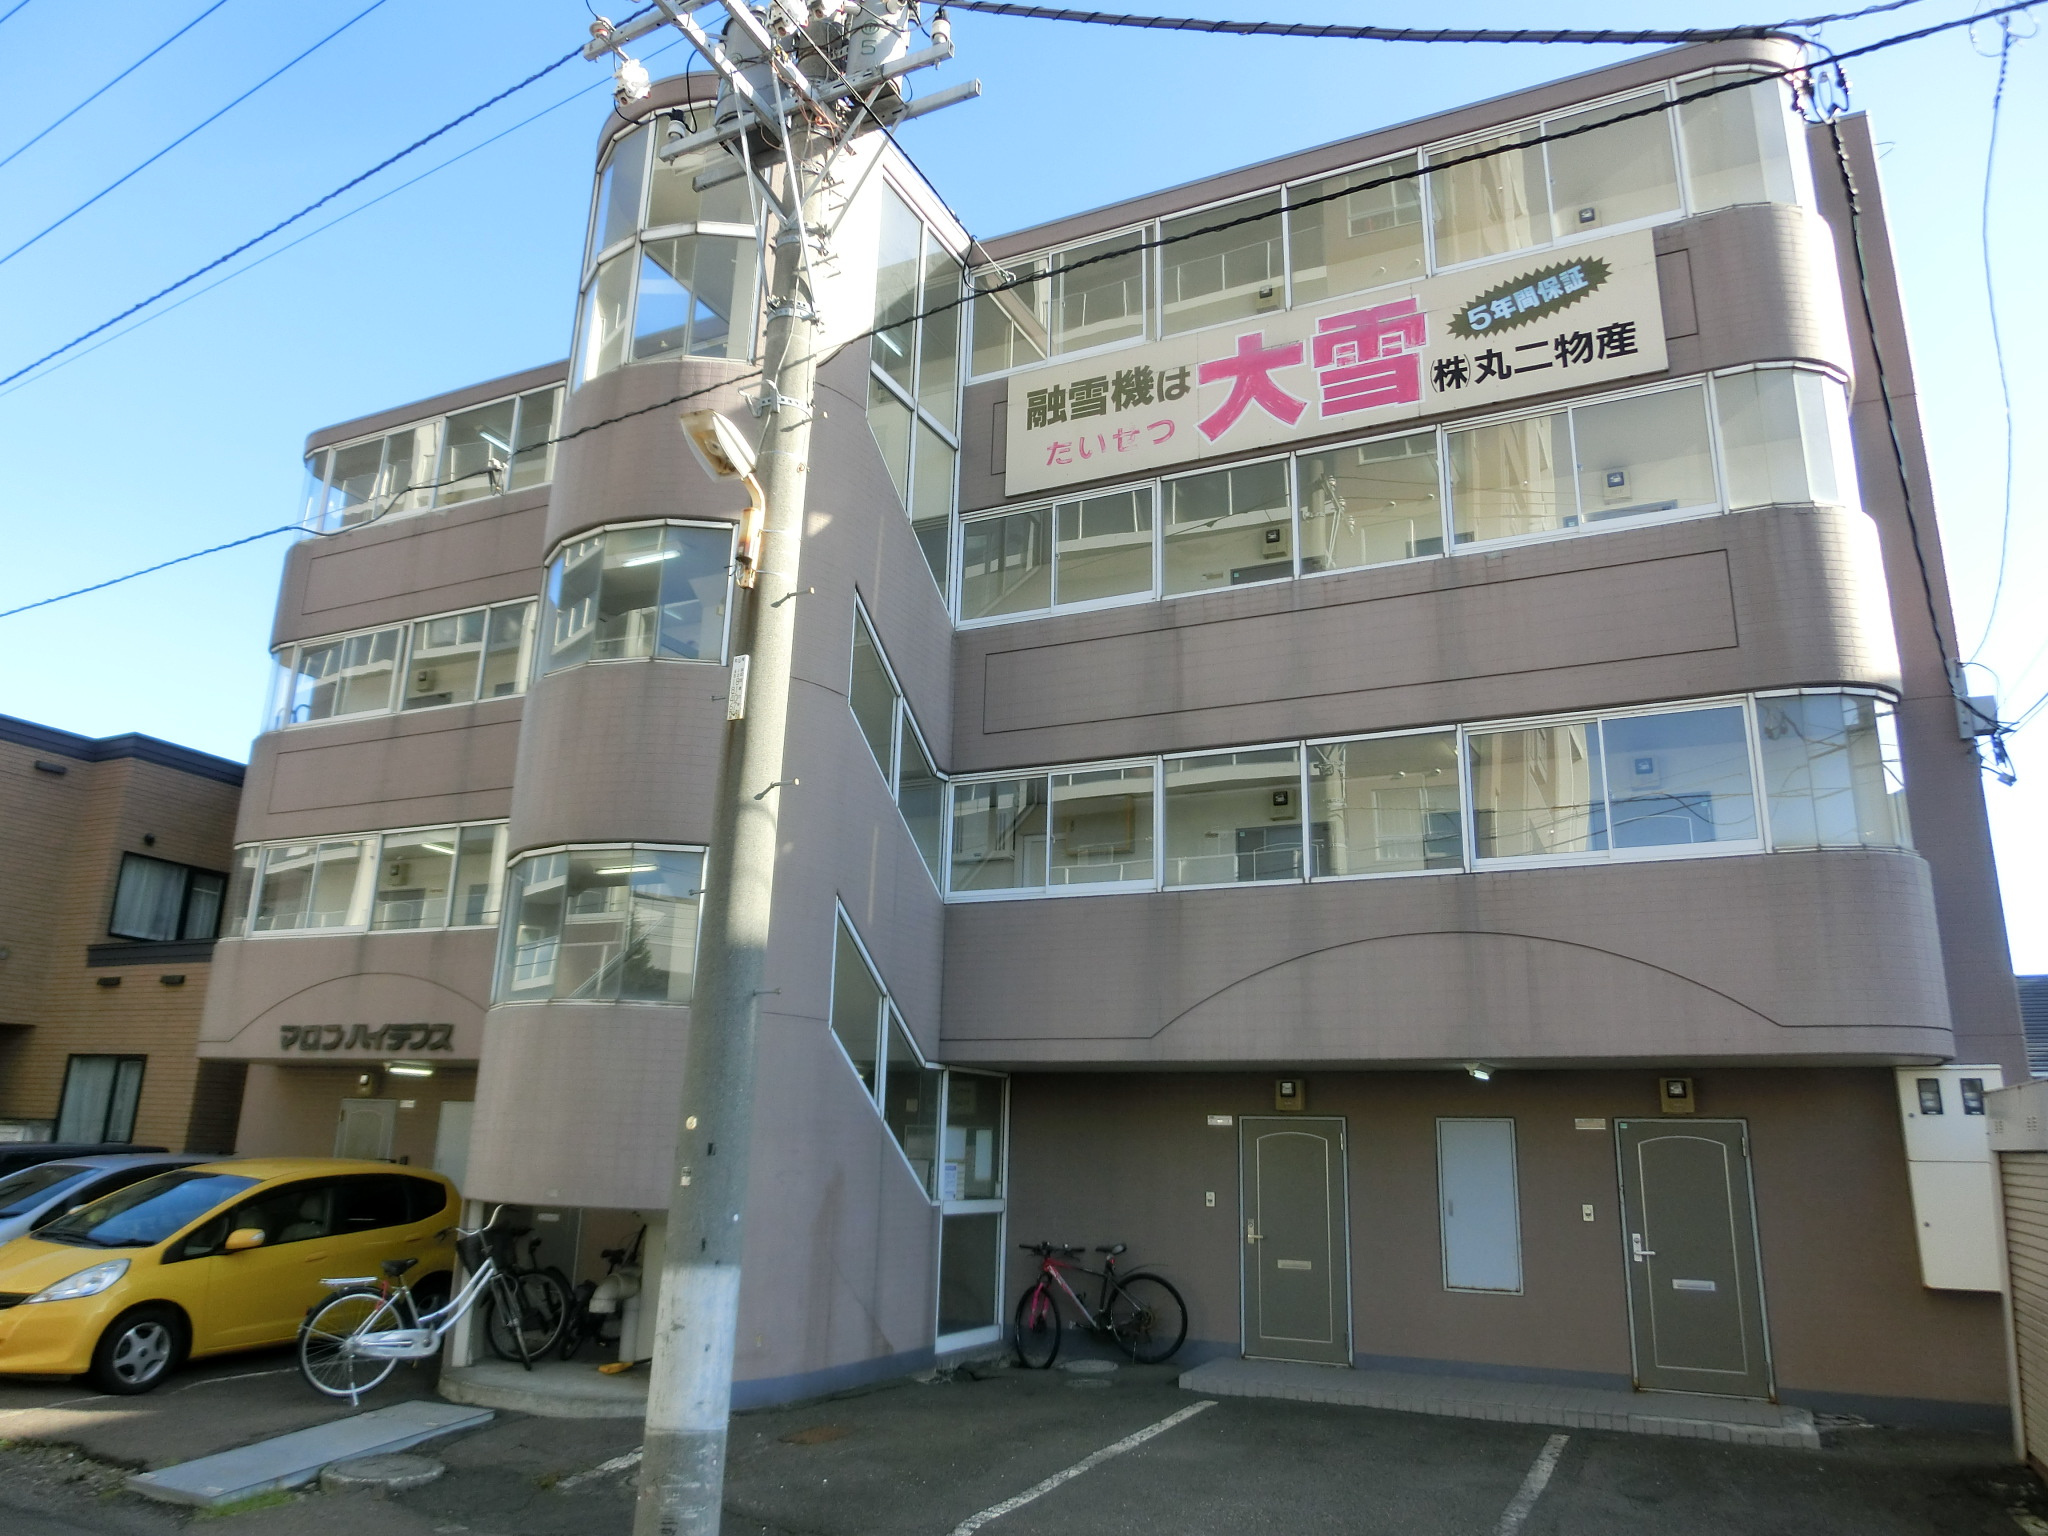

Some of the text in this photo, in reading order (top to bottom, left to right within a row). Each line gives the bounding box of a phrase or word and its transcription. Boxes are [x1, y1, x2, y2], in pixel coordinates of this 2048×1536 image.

[1467, 265, 1589, 331] 5年間保証
[1027, 296, 1428, 443] 融雪機は 大雪
[1046, 419, 1175, 466] たいせつ
